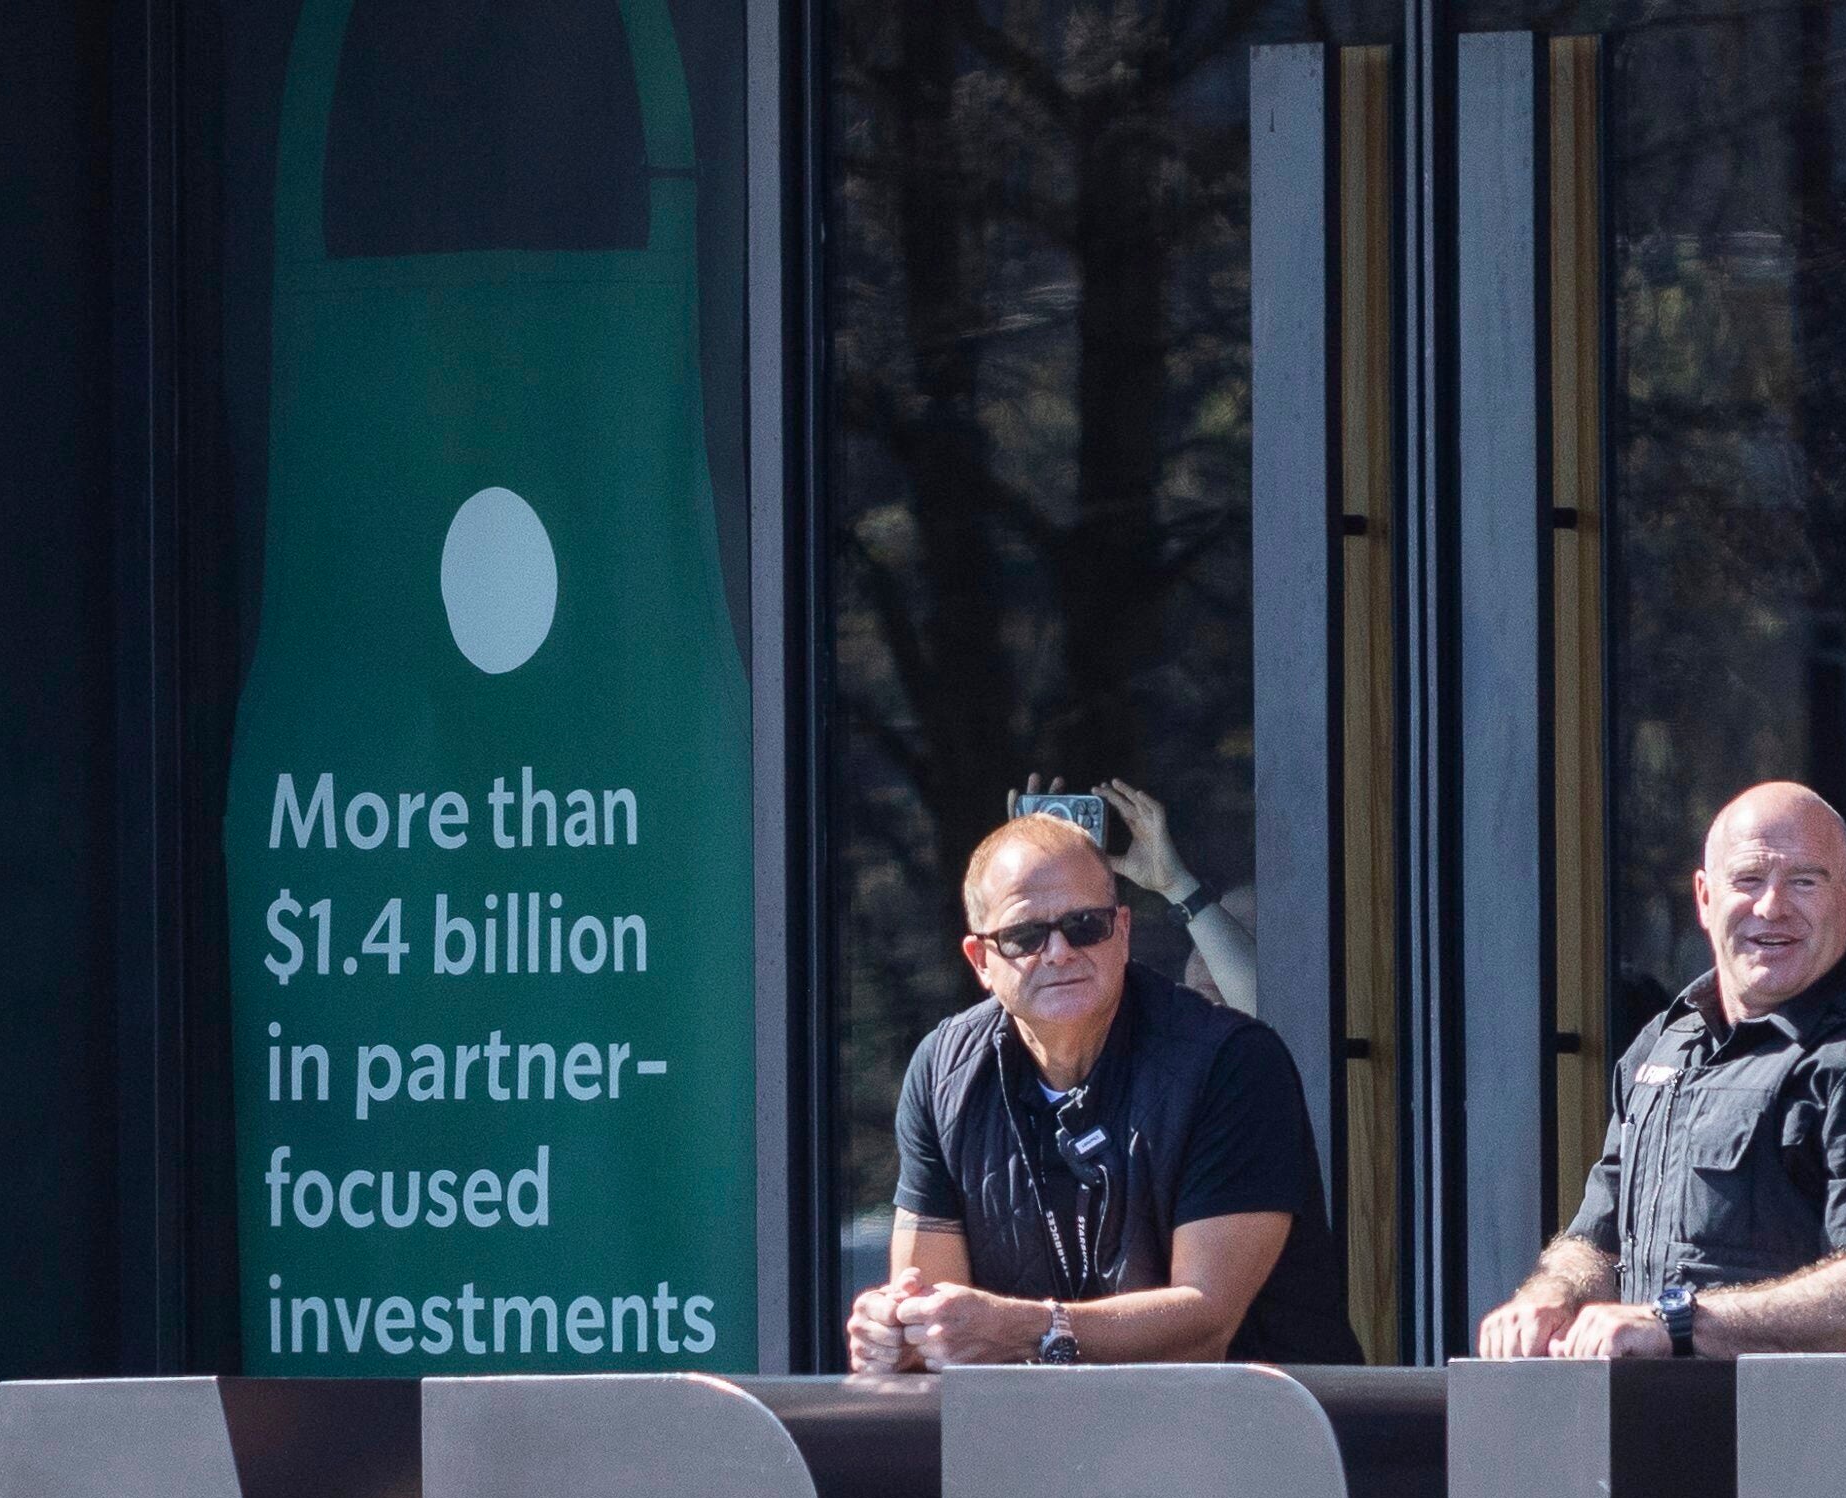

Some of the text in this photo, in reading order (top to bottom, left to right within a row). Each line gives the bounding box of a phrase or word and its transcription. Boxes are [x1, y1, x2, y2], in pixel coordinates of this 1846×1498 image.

[267, 766, 638, 850] More than
[263, 889, 648, 986] $1.4 billion
[268, 1021, 668, 1121] in partner-
[264, 1144, 551, 1228] focused
[268, 1273, 717, 1355] investments
